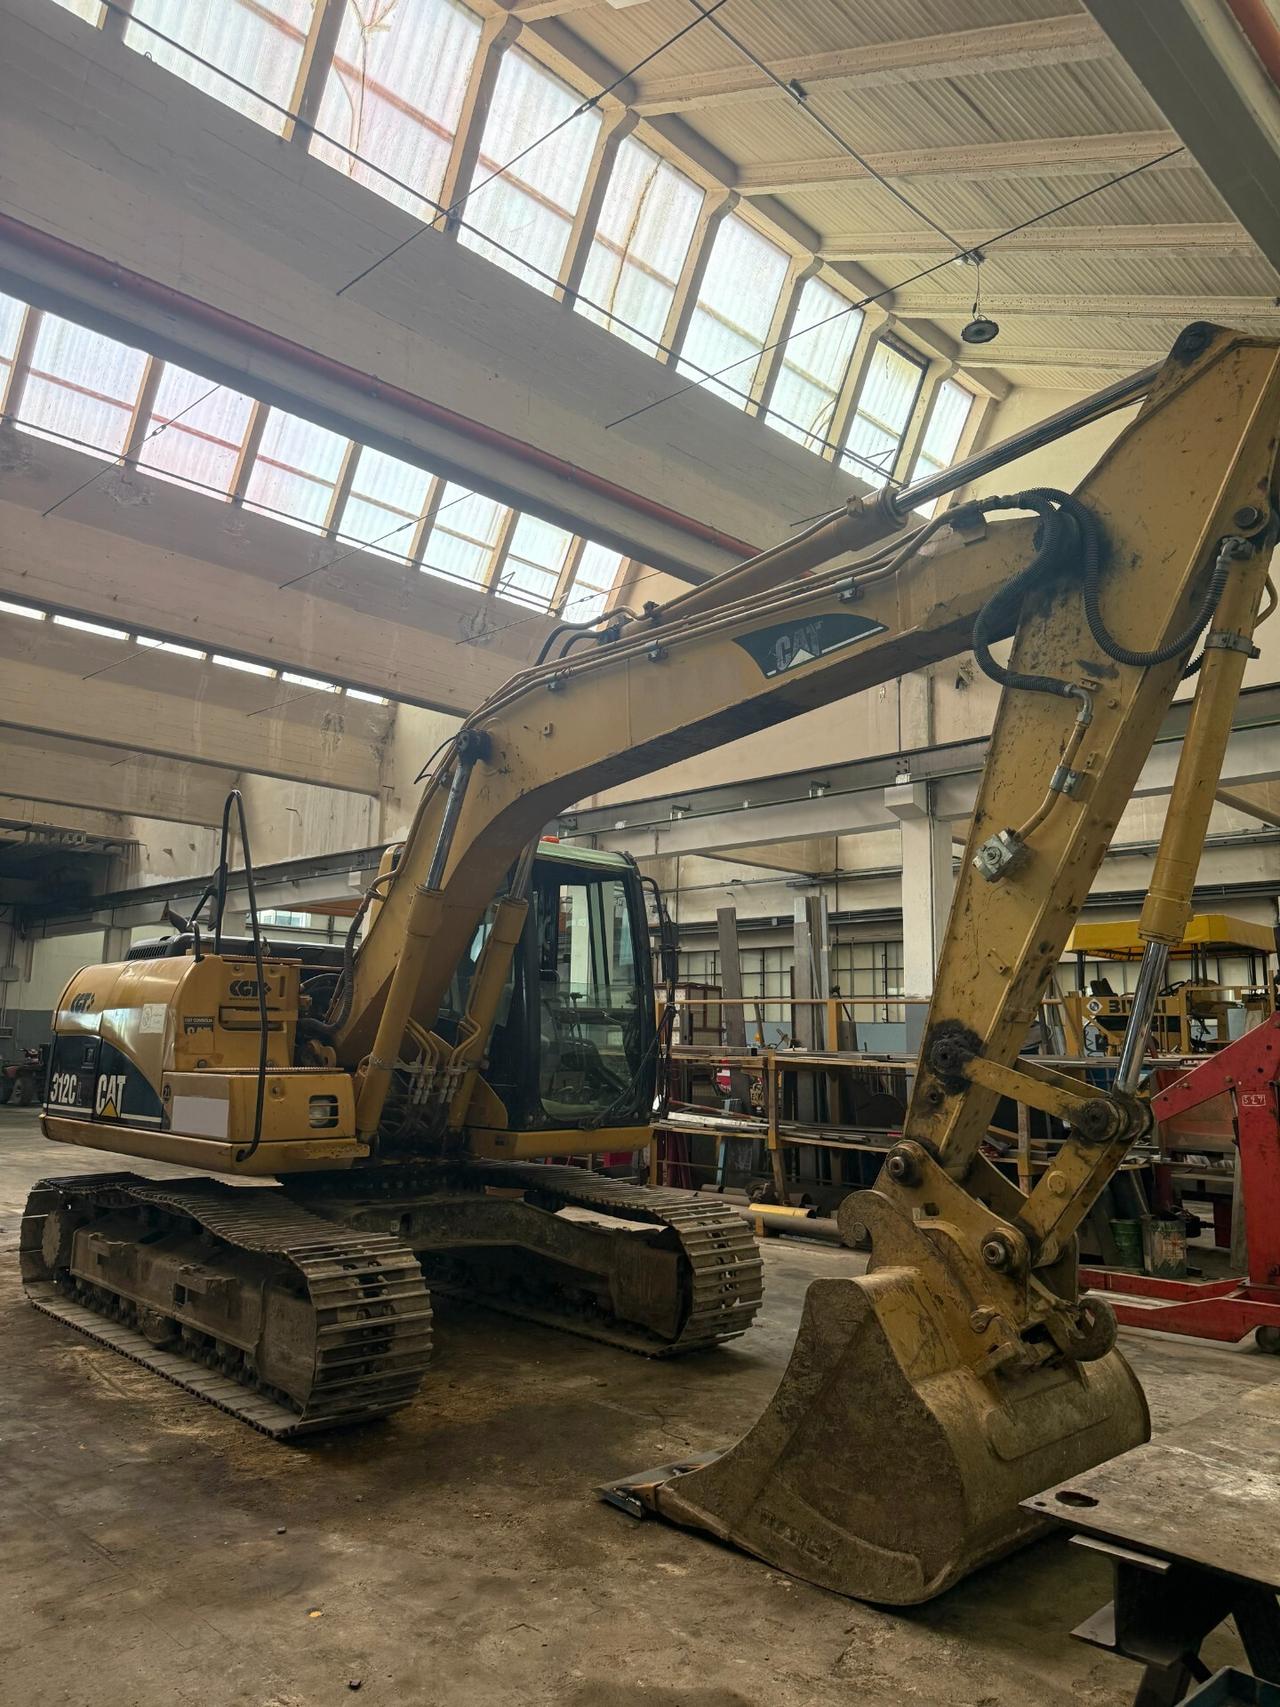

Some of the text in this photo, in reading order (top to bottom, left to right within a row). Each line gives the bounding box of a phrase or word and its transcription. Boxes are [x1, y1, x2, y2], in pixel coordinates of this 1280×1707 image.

[776, 620, 823, 671] CAT
[50, 1072, 77, 1104] 312C
[95, 1074, 127, 1118] CAT
